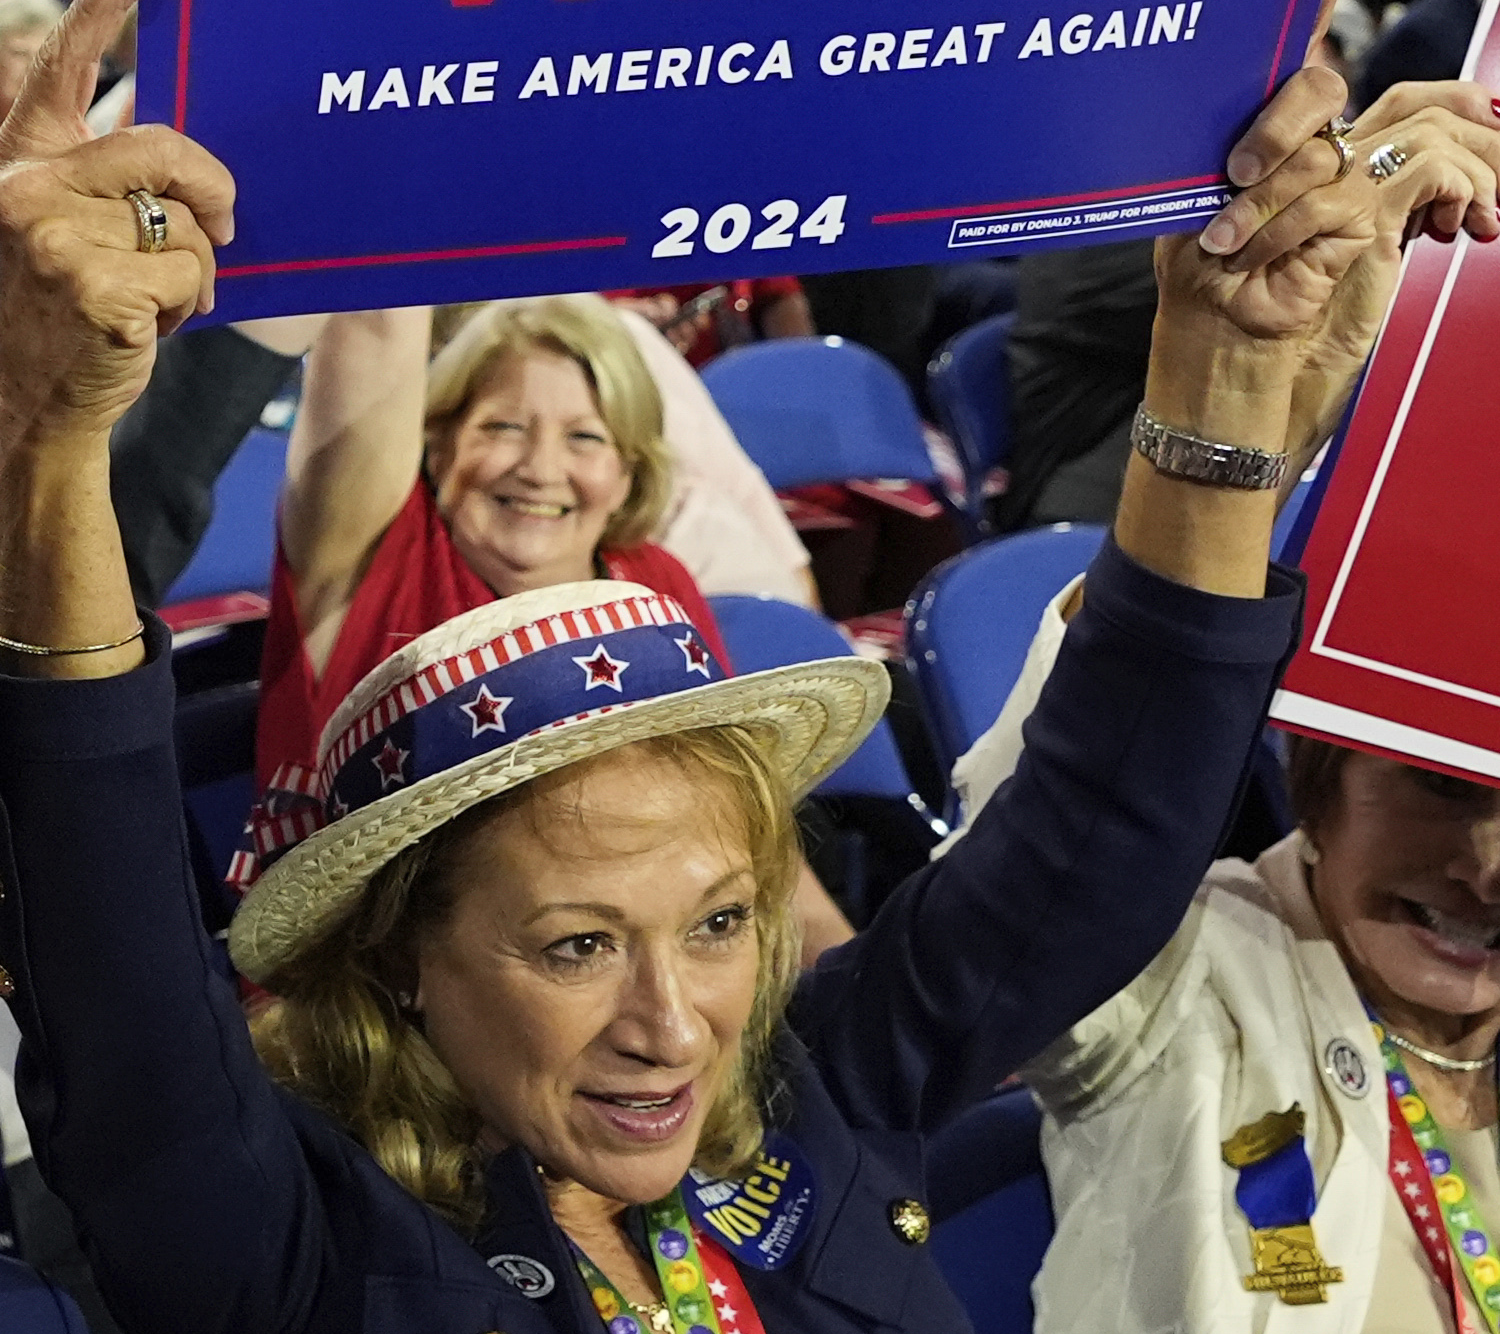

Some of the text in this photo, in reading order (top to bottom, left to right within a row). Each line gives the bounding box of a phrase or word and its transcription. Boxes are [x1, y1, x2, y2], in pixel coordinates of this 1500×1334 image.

[318, 1, 1203, 114] MAKE AMERICA GREAT AGAIN!
[651, 195, 846, 258] 2024
[959, 226, 985, 238] PAID
[986, 223, 1010, 235] FOR
[1010, 222, 1026, 233] BY
[1026, 216, 1072, 231] DONALD
[1084, 209, 1119, 224] TRUMP
[1119, 207, 1141, 219] FOR
[1141, 198, 1195, 216] PRESIDENT
[1194, 195, 1221, 209] 2024,
[702, 1151, 791, 1245] VOICE
[758, 1214, 787, 1253] MOMS
